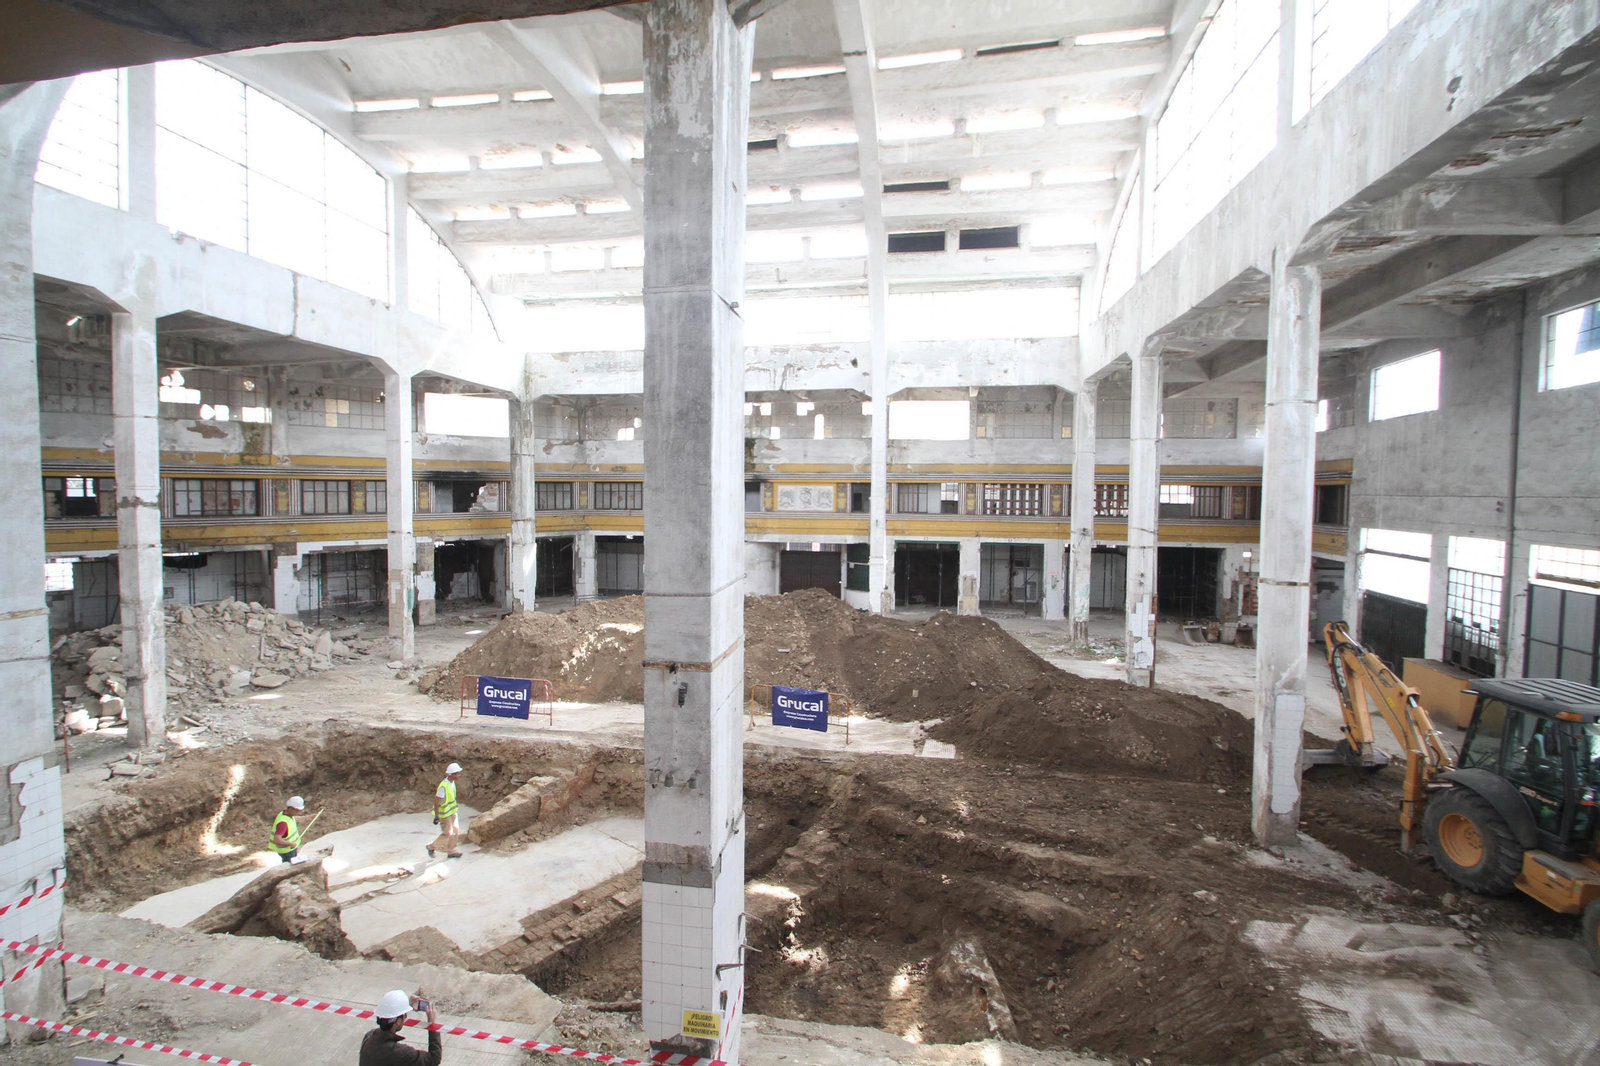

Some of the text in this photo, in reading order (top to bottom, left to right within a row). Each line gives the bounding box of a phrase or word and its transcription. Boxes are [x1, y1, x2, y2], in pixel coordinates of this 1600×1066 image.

[483, 685, 527, 701] Grucal
[777, 695, 823, 712] Grucal
[687, 1020, 716, 1029] MAQUINARIA
[690, 1028, 720, 1037] MOVIMIENTO
